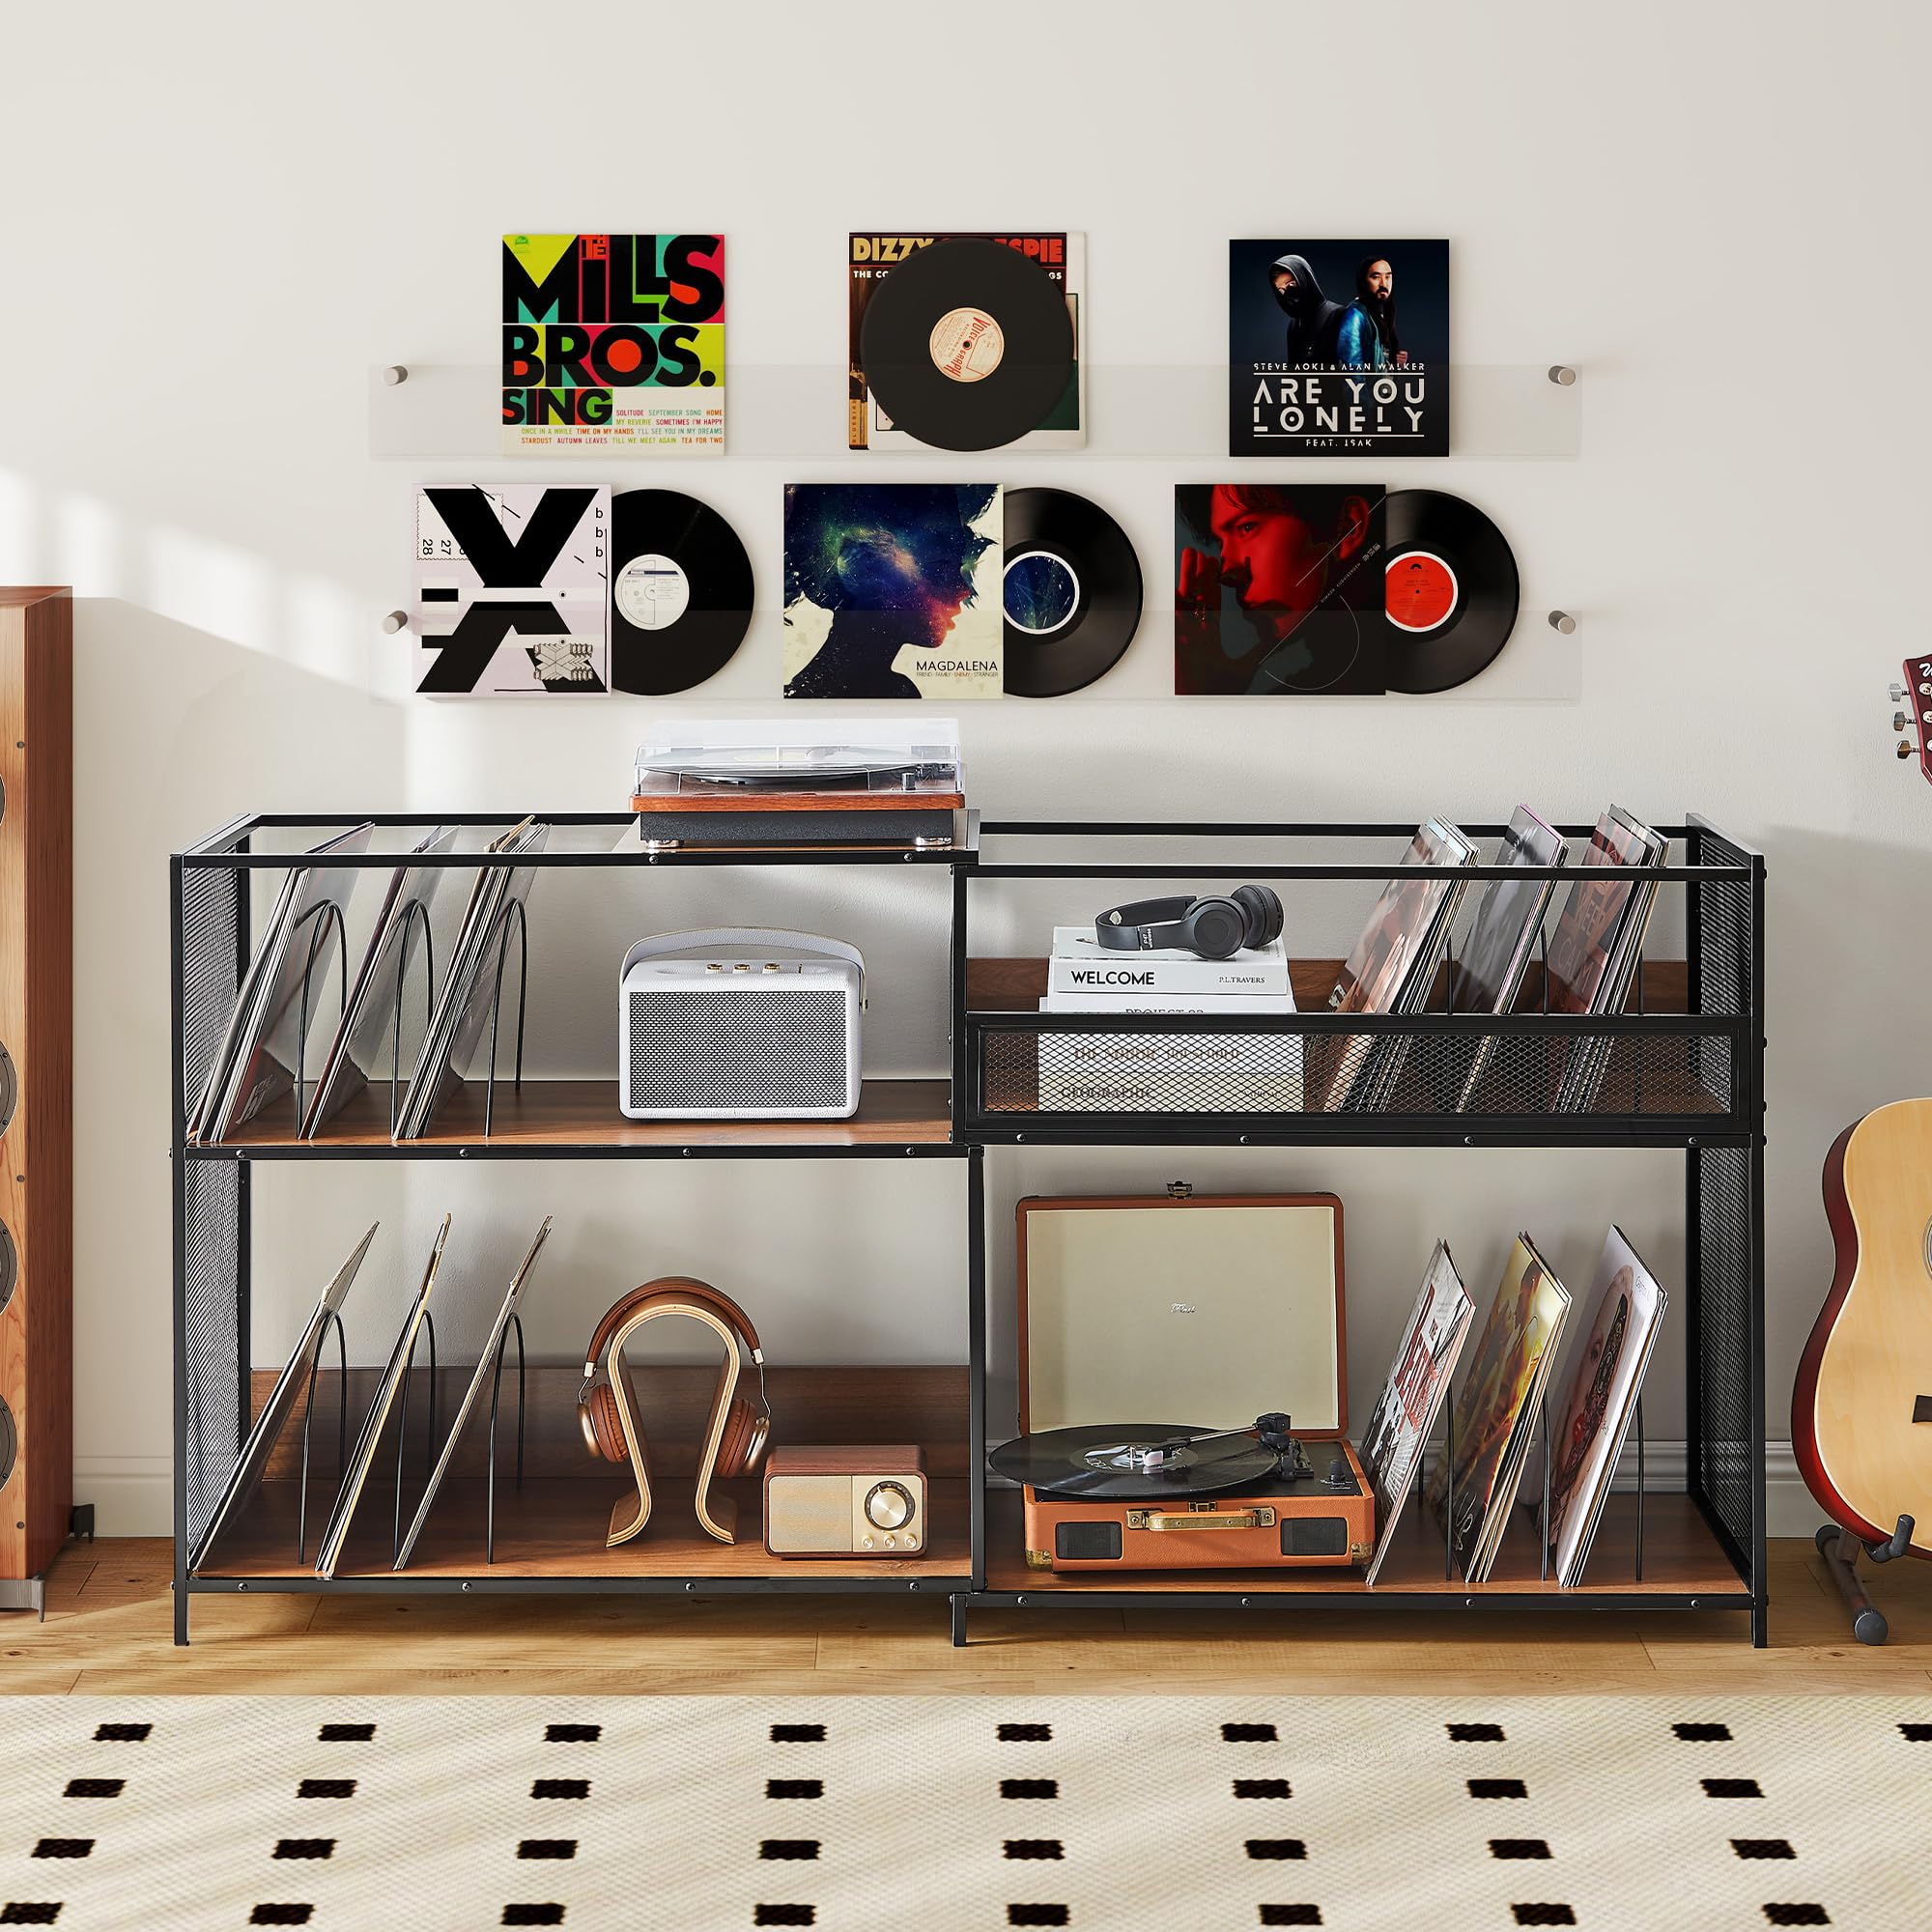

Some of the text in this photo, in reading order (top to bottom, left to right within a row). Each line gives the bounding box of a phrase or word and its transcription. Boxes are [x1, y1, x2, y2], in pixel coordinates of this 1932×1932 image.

[502, 235, 724, 323] MILLS
[502, 325, 716, 386] BROS.
[944, 350, 966, 377] GRAPH
[1253, 378, 1425, 404] ARE YOU
[502, 388, 612, 425] SING
[1253, 407, 1424, 432] LONELY
[422, 539, 433, 555] 28
[441, 540, 451, 555] 27
[916, 661, 998, 671] MAGDALENA
[1071, 971, 1155, 985] WELCOME
